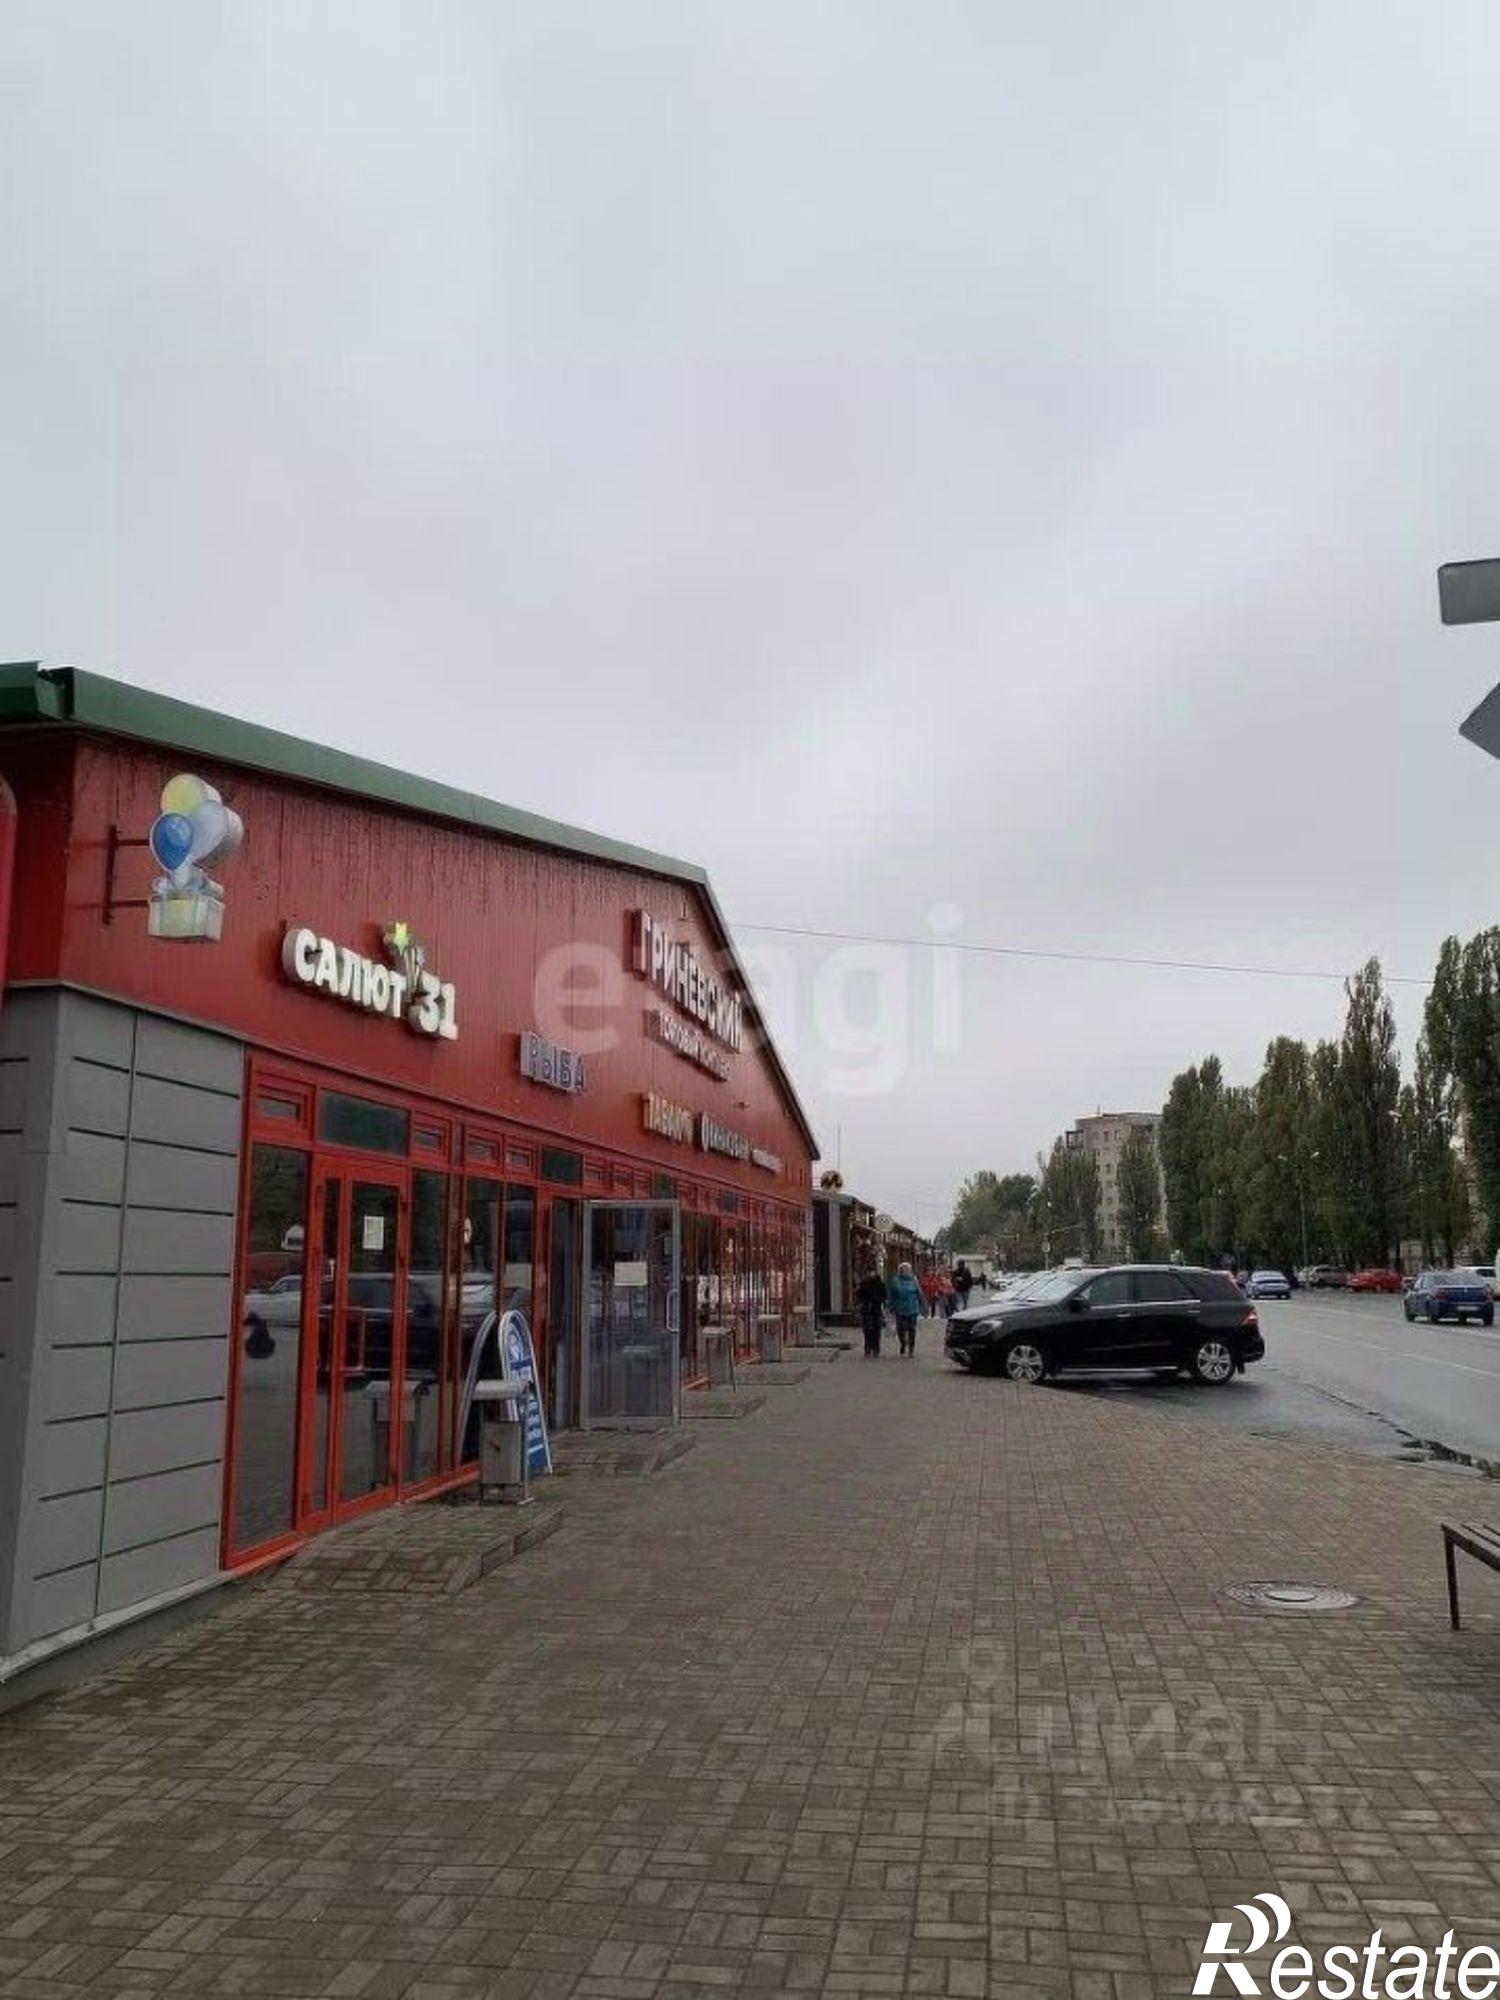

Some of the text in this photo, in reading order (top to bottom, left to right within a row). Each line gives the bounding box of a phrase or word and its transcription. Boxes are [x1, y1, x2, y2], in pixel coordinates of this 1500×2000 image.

[284, 926, 458, 1040] САЛЮТ 31
[521, 1033, 585, 1094] РЫБА
